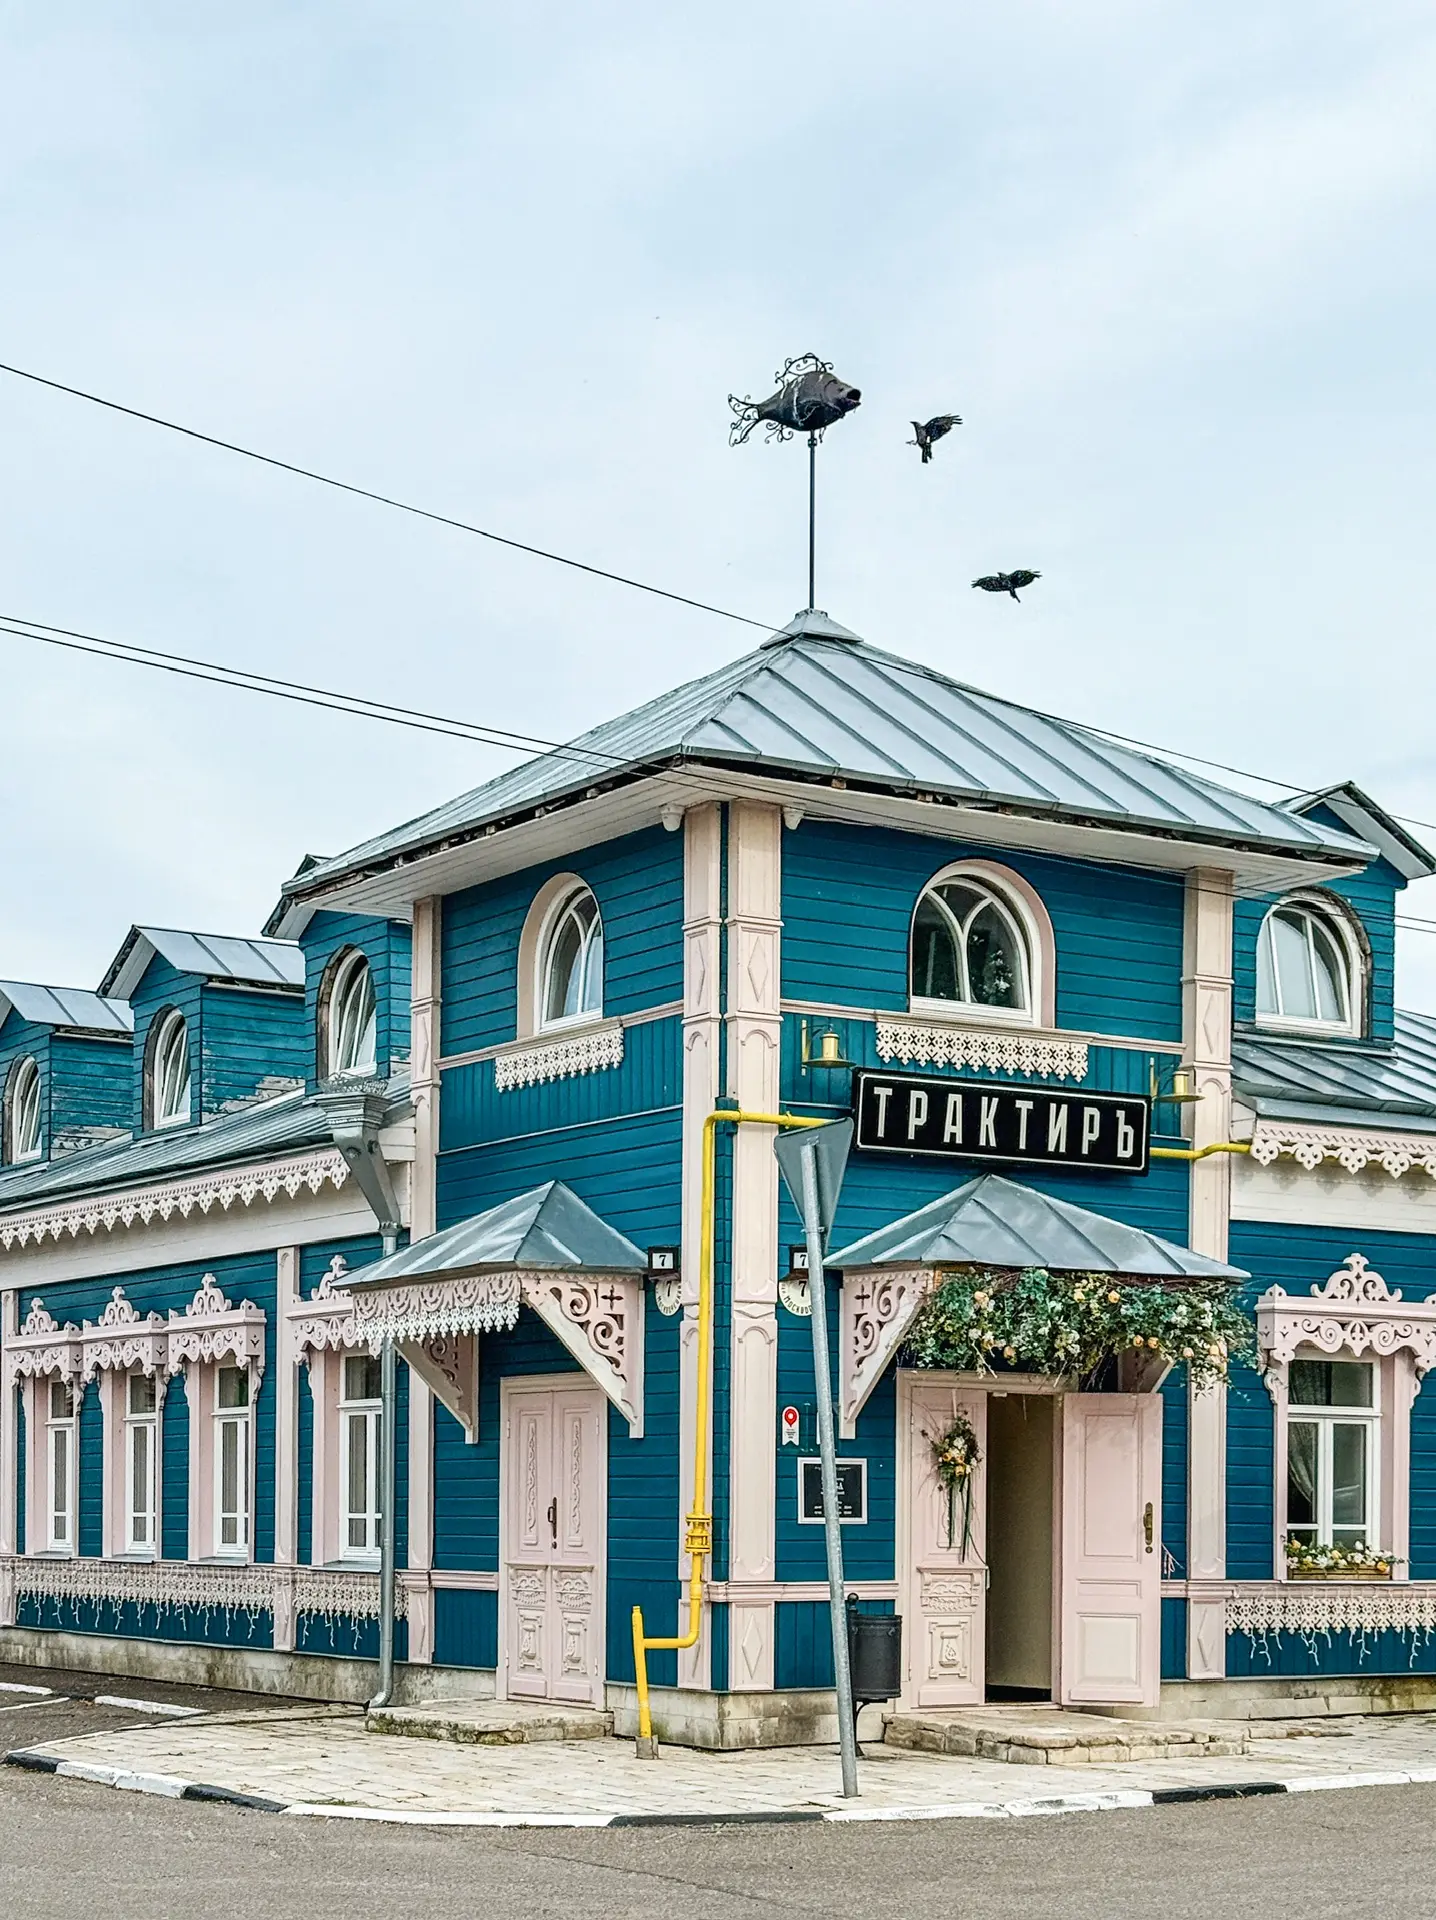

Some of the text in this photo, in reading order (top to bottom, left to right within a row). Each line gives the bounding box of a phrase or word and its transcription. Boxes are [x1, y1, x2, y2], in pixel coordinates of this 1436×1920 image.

[873, 1086, 1135, 1159] ТРАКТИРЪ
[659, 1254, 667, 1267] 7
[799, 1254, 807, 1267] 7
[666, 1280, 672, 1297] 7
[798, 1280, 807, 1297] 7
